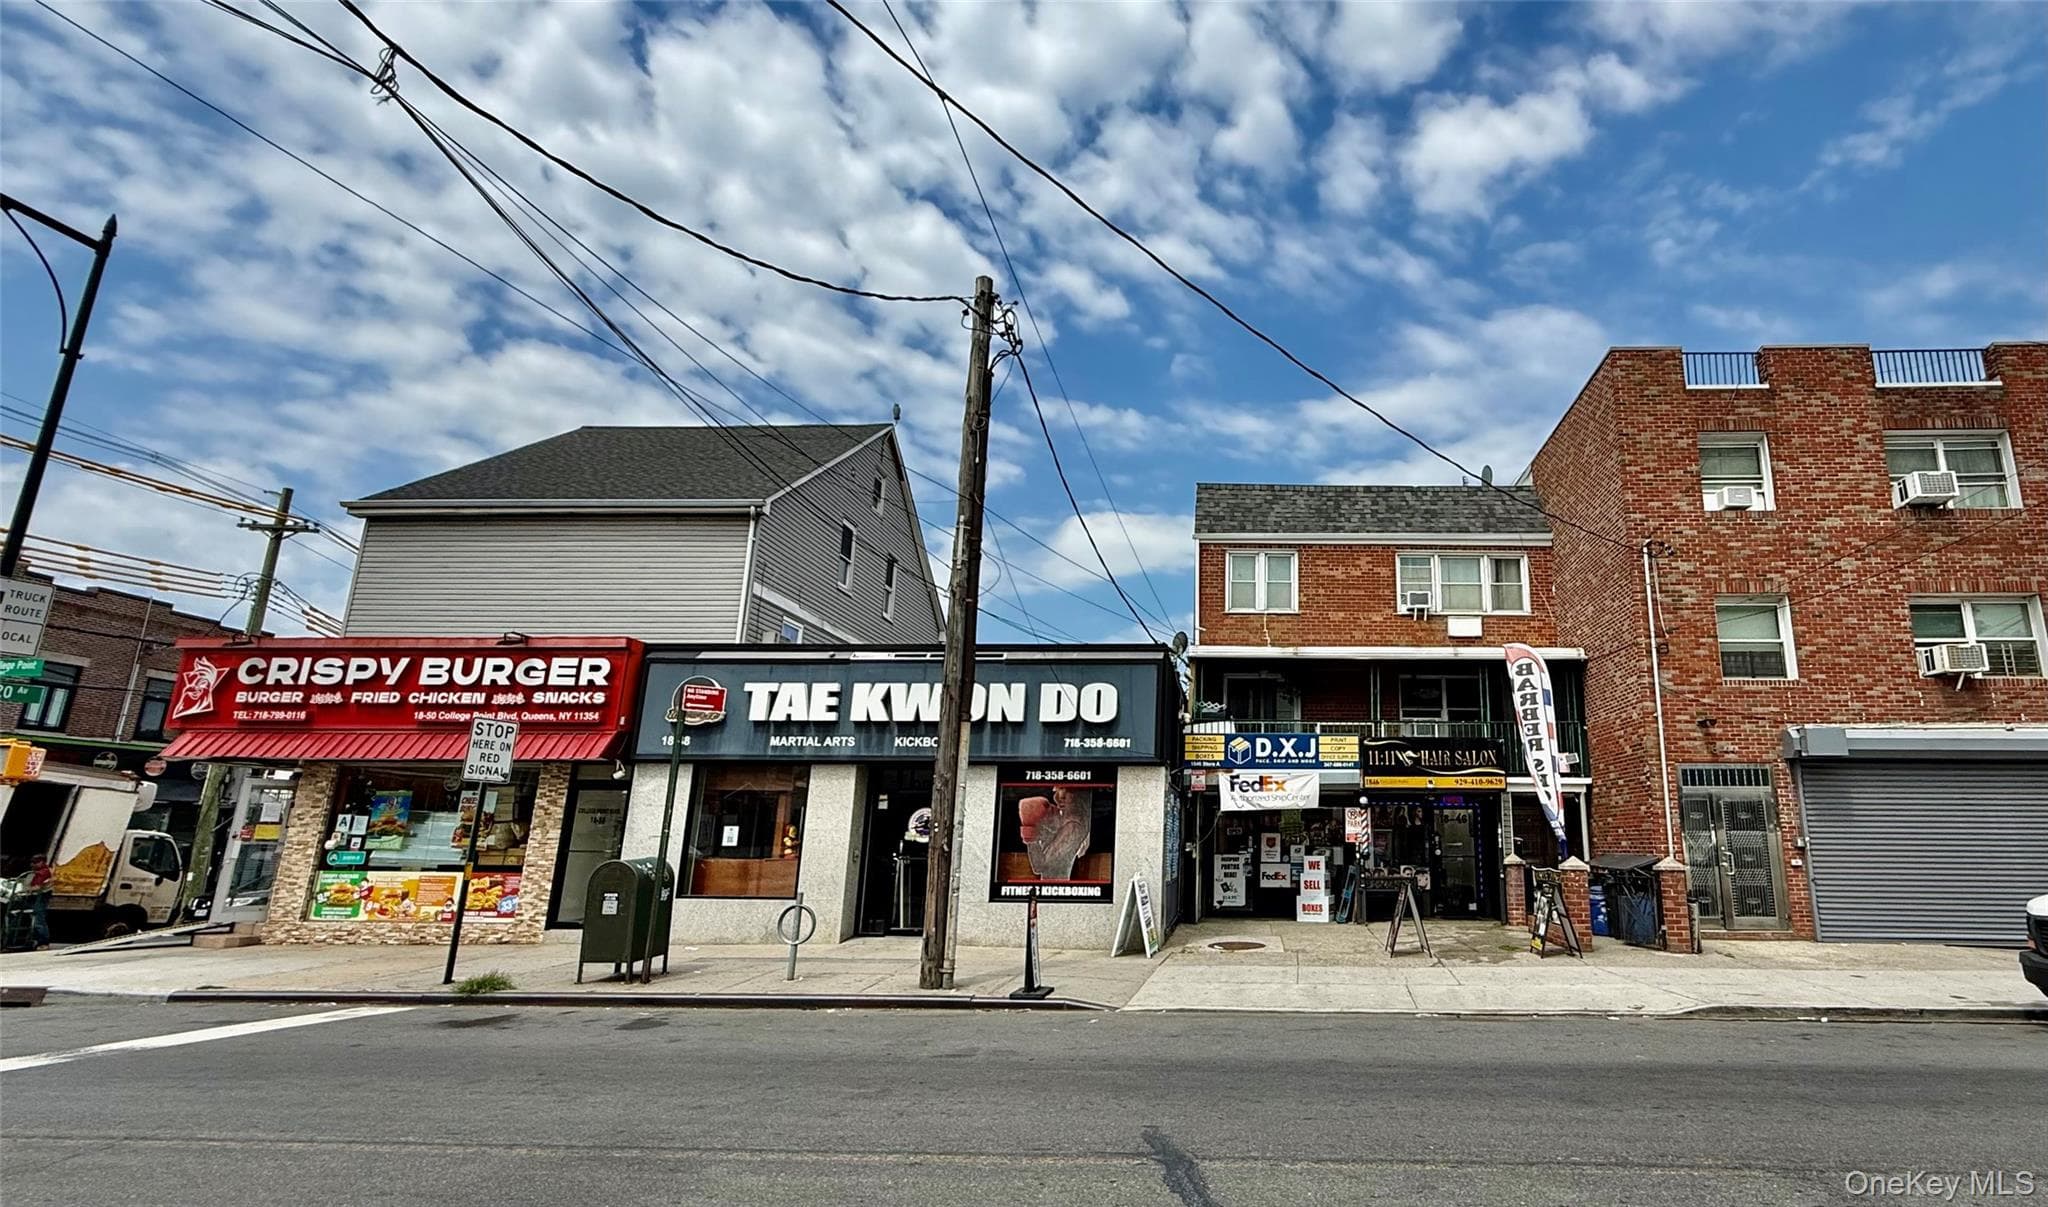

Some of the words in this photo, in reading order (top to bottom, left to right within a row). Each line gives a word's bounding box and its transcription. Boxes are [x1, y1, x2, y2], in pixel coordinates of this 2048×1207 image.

[10, 589, 47, 603] TRUCK
[4, 604, 42, 618] ROUTE
[0, 631, 32, 644] OCAL
[237, 657, 410, 685] CRISPY
[418, 657, 611, 686] BURGER
[235, 692, 304, 703] BURGER
[351, 692, 400, 703] FRIED
[408, 692, 486, 704] CHICKEN
[532, 692, 606, 704] SNACKS
[744, 682, 841, 721] TAE
[1039, 682, 1118, 723] DO
[233, 711, 251, 719] TEL:
[438, 712, 471, 721] College
[497, 712, 519, 721] Blvd,
[521, 712, 557, 721] Queens,
[559, 712, 572, 720] NY
[574, 712, 599, 720] 11354
[475, 722, 514, 739] STOP
[472, 739, 496, 750] HERE
[500, 741, 511, 752] ON
[770, 736, 821, 747] MARTIAL
[823, 736, 856, 747] ARTS
[1255, 738, 1316, 757] D.X.J
[480, 753, 500, 763] RED
[1421, 750, 1450, 766] HAIR
[1455, 750, 1497, 766] SALON
[468, 765, 504, 777] SIGNAL
[1026, 771, 1091, 781] 718-358-6601
[1229, 775, 1287, 792] FedEx
[339, 816, 348, 827] A
[1439, 813, 1467, 824] 18-46
[1308, 861, 1320, 870] WE
[1262, 872, 1287, 880] FedEx
[1304, 880, 1320, 890] SELL
[1041, 886, 1101, 897] KICKBOXING
[1302, 903, 1323, 912] BOXES
